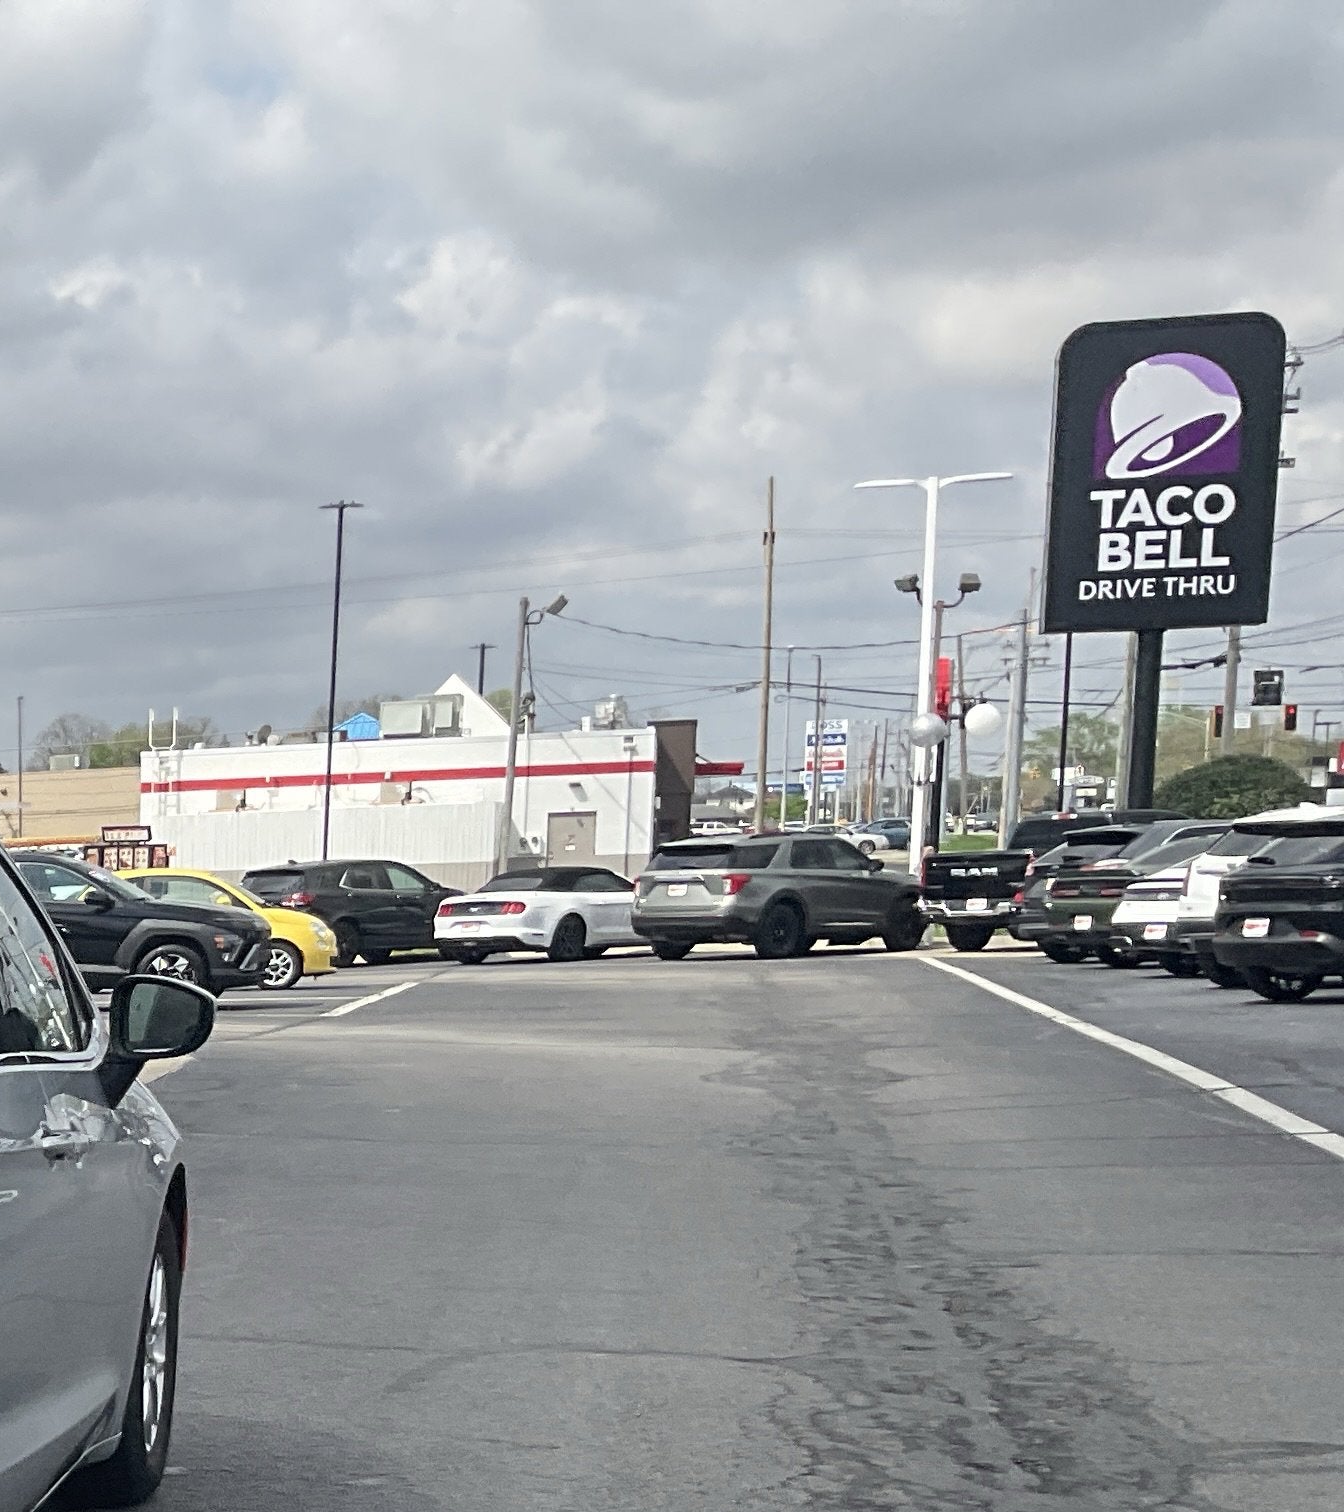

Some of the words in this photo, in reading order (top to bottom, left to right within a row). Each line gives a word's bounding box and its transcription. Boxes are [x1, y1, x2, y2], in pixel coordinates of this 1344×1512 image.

[1090, 483, 1236, 529] TACO
[1097, 527, 1231, 572] BELL
[1078, 577, 1156, 601] DRIVE
[1162, 574, 1236, 597] THRU
